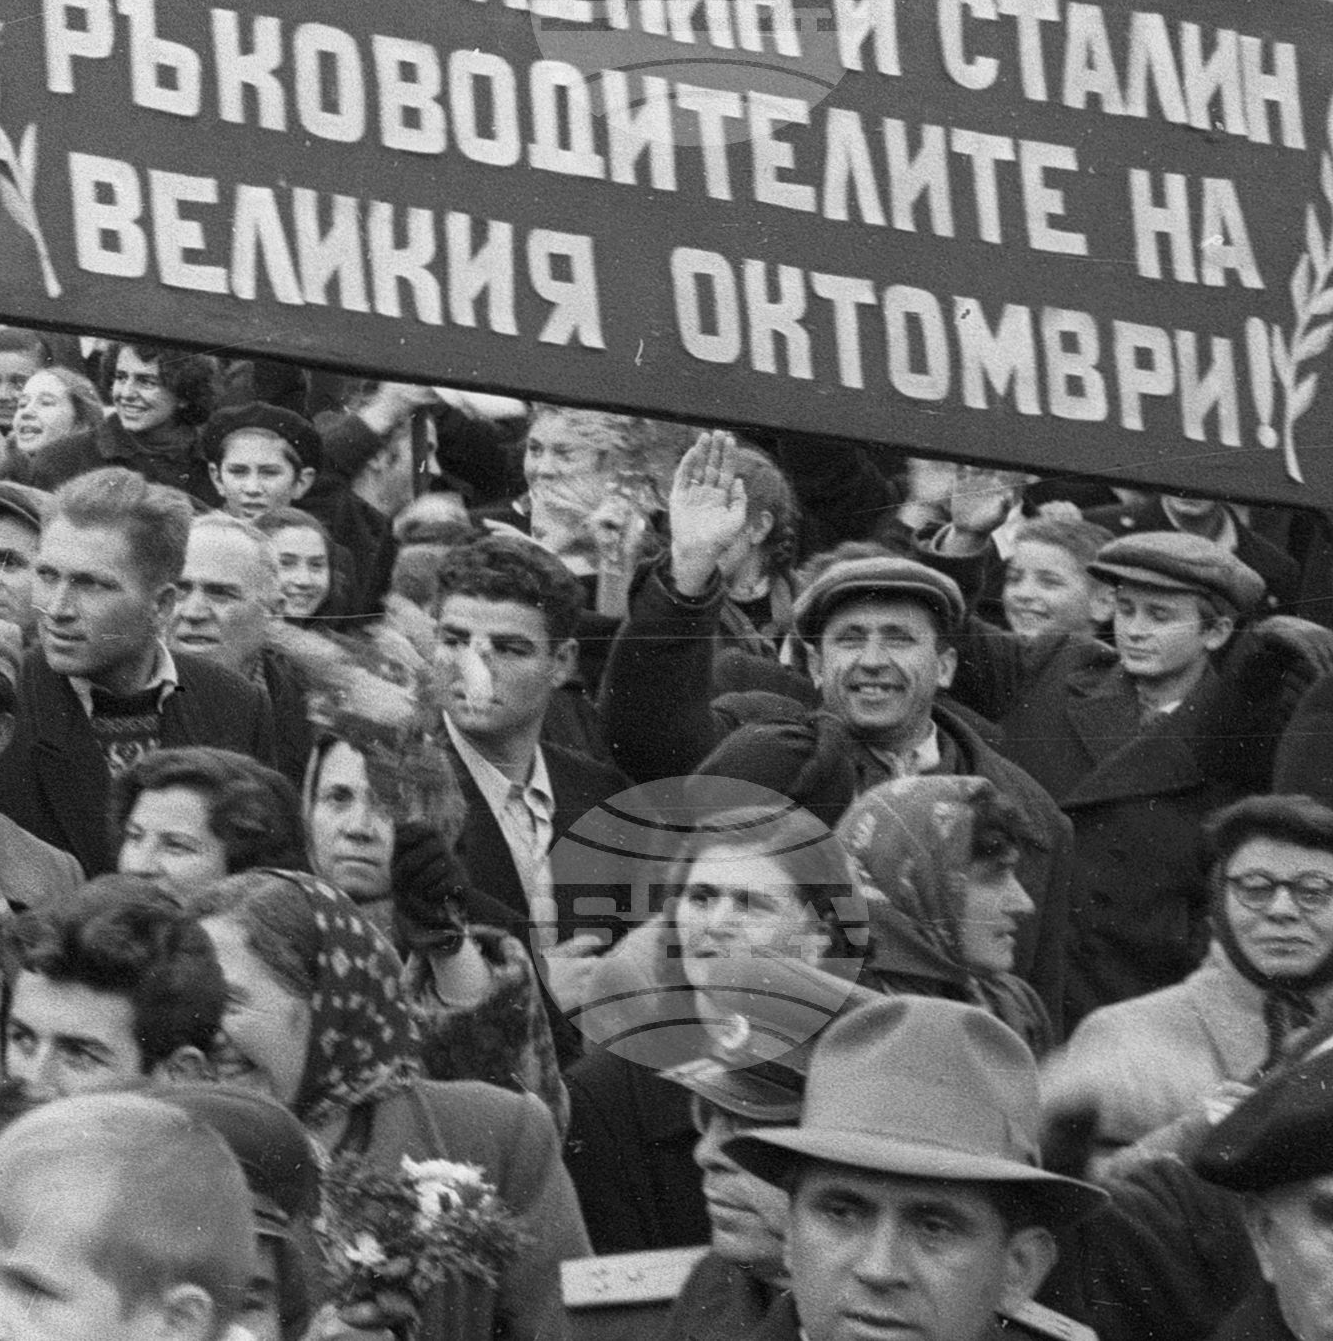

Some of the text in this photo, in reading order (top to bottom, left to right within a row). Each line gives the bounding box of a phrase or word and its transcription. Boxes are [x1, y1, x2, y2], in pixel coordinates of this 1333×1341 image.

[68, 151, 1278, 448] ВЕЛИКИЯ ОКТОМВРИ!
[1130, 168, 1264, 289] НА
